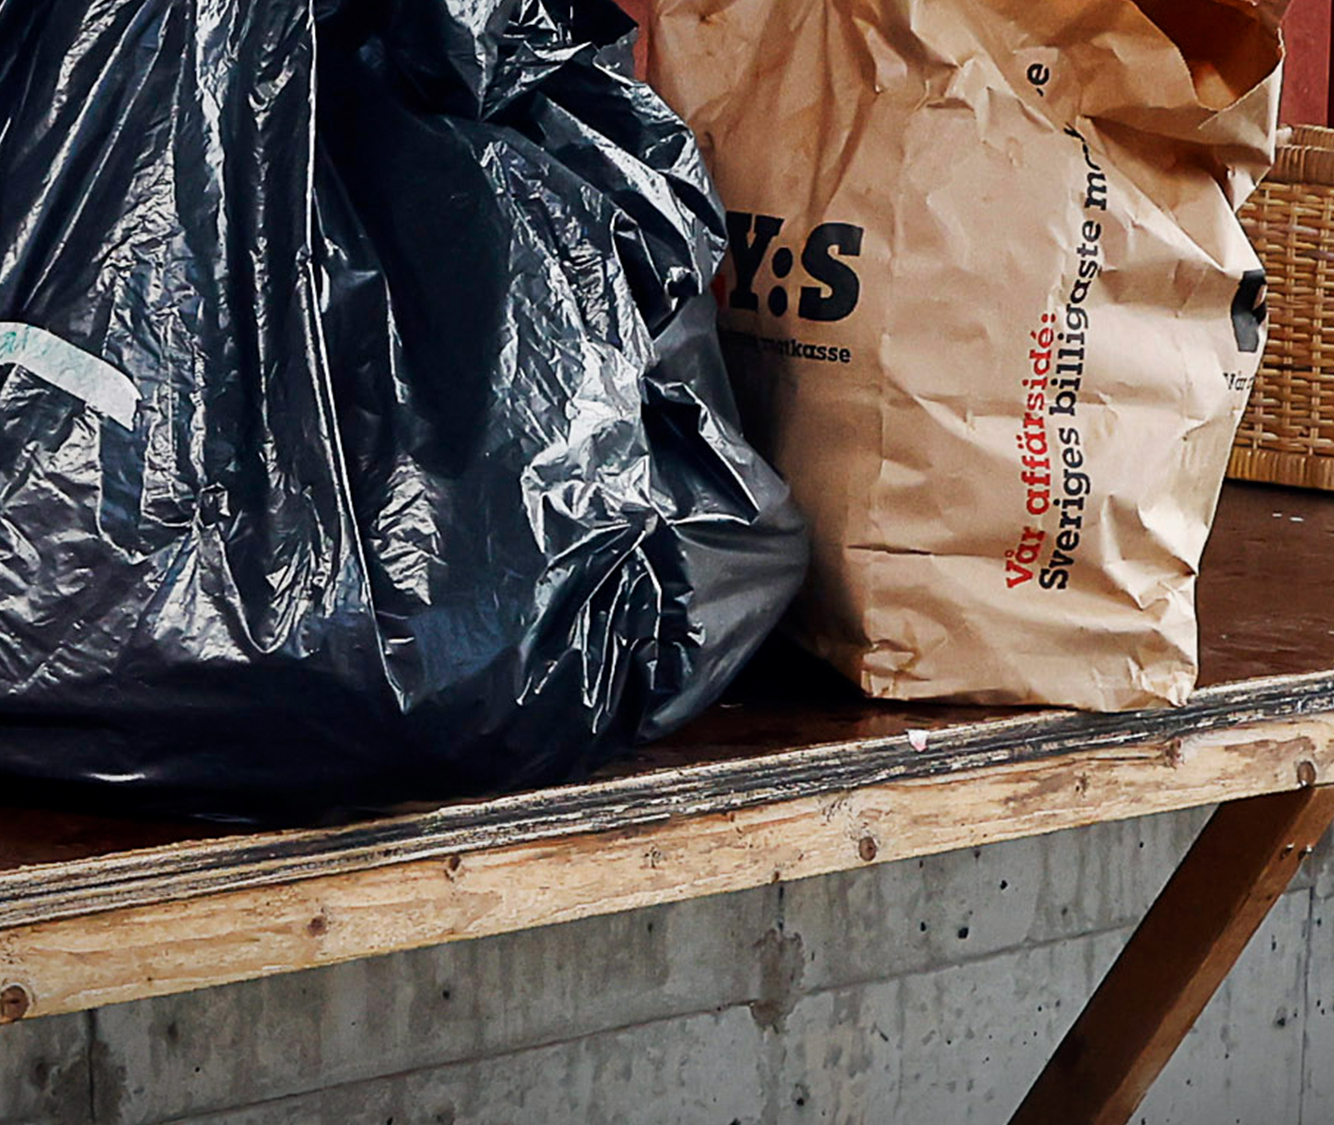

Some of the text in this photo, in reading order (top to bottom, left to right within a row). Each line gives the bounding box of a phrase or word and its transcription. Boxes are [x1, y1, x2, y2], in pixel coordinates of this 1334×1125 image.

[712, 210, 865, 322] Y:S
[1048, 220, 1102, 416] billigaste
[1005, 313, 1057, 588] Vår affärsidé:
[1038, 427, 1091, 591] Sveriges
